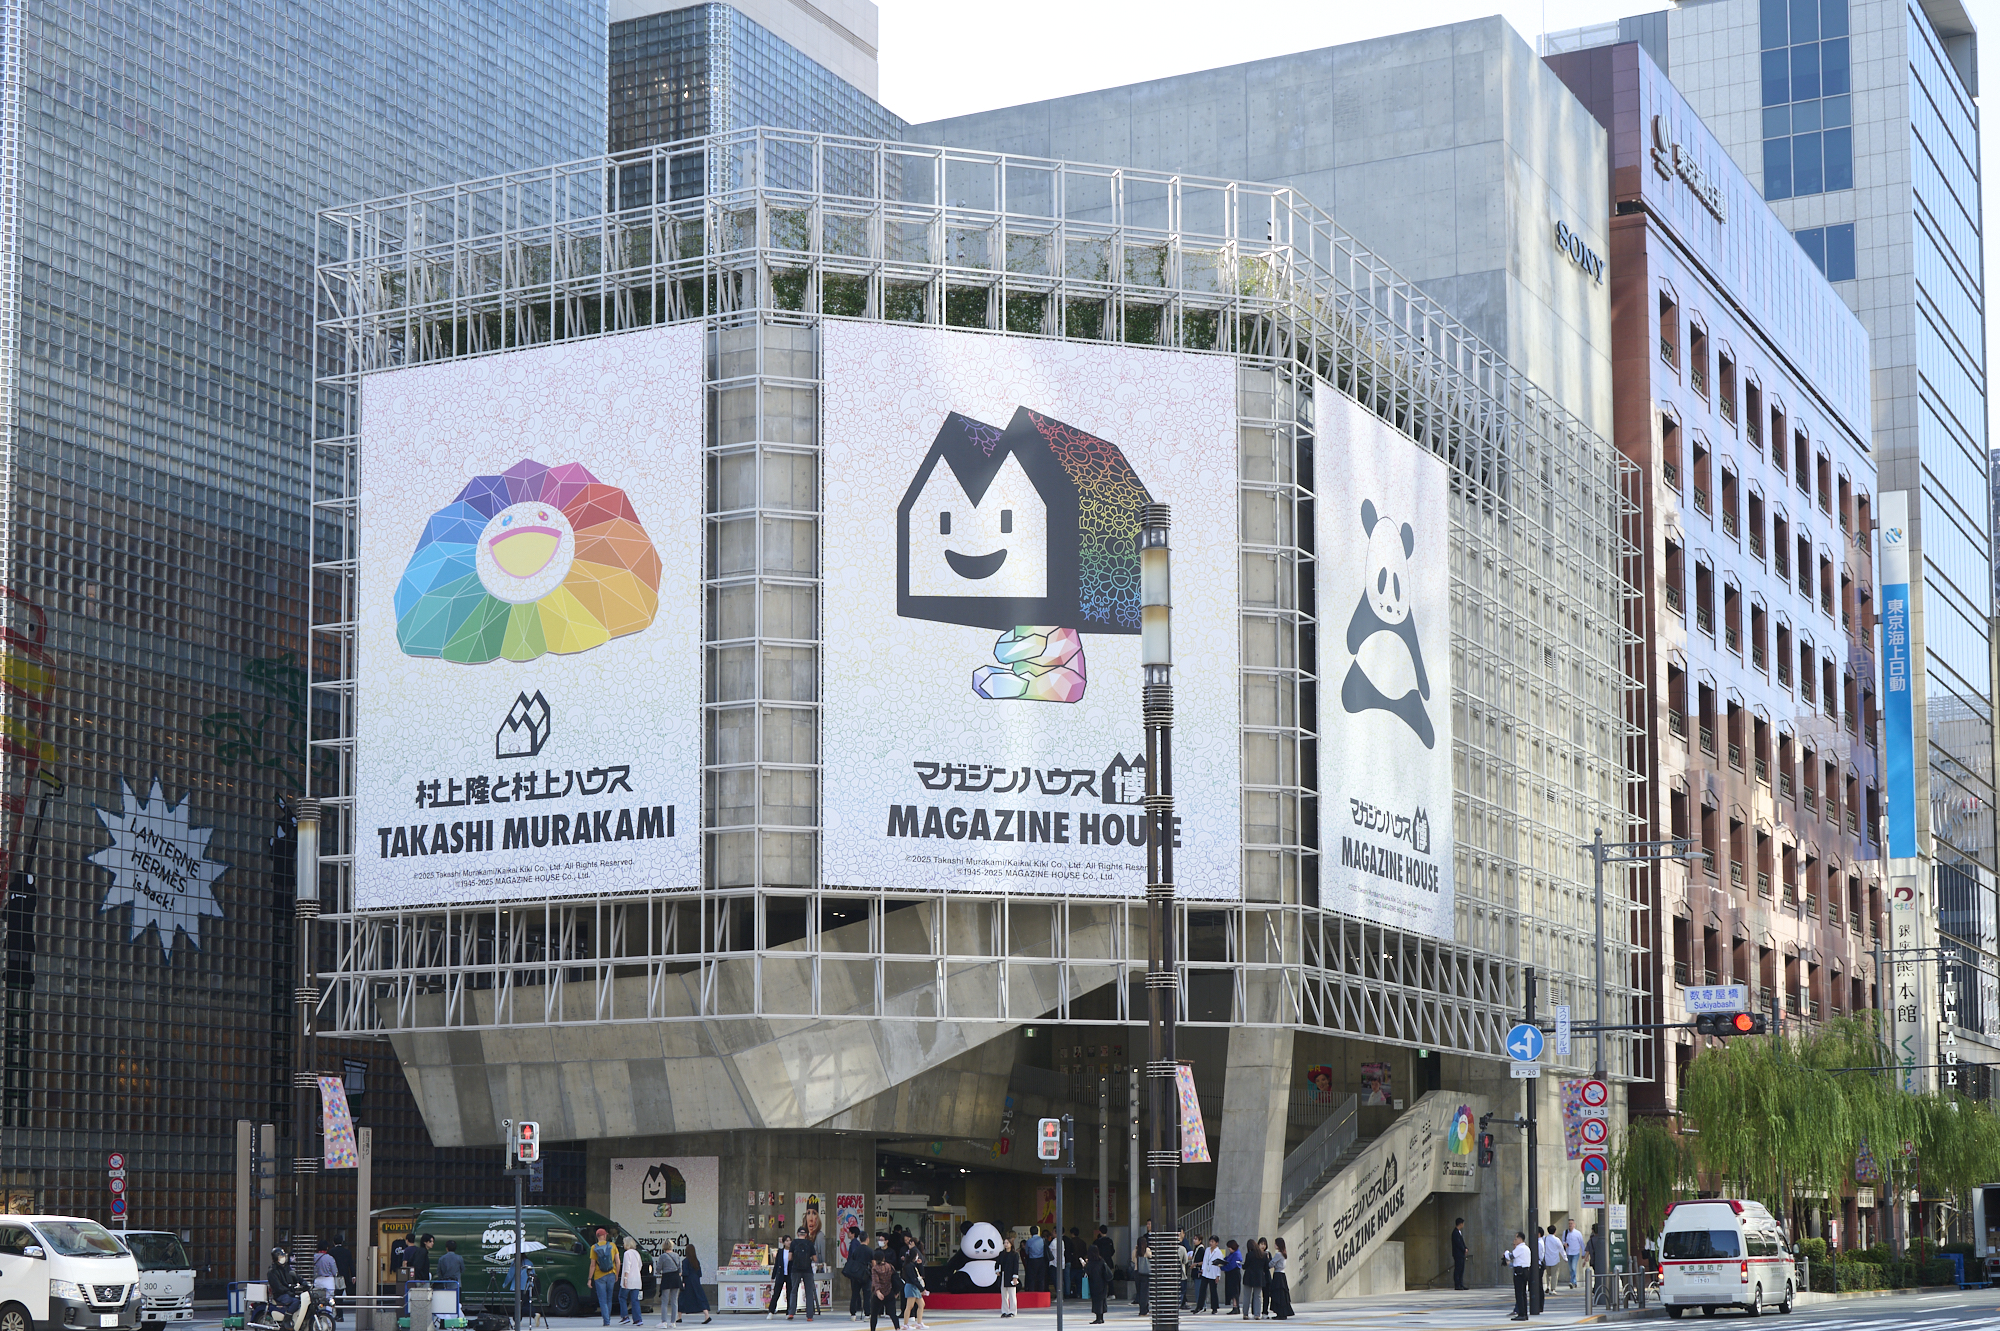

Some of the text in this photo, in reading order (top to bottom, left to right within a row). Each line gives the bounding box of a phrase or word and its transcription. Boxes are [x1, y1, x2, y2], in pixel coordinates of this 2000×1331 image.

[1557, 220, 1606, 285] SONY
[1887, 599, 1906, 692] 東京海上日動
[416, 764, 634, 809] 村上隆と村上ハウス
[378, 805, 676, 859] TAKASHI MURAKAMI
[886, 804, 1182, 849] MAGAZINE HOUE
[130, 817, 200, 879] LANTERNE
[131, 847, 187, 894] HERMÈS
[436, 871, 461, 879] Takashi
[520, 865, 533, 873] Kiki
[564, 862, 574, 870] All
[575, 861, 598, 869] Rights
[600, 859, 635, 868] Reserved.
[933, 856, 964, 866] Takashi
[1034, 858, 1049, 868] Kiki
[1069, 860, 1084, 869] Ltd.
[1085, 860, 1096, 870] All
[1098, 861, 1123, 871] Rights
[1005, 869, 1049, 879] MAGAZINE
[1051, 870, 1081, 880] HOUSE
[1100, 871, 1115, 881] Ltd.
[1342, 836, 1439, 894] MAGAZINE HOUSE
[133, 873, 175, 912] is back!
[495, 875, 533, 885] MAGAZINE
[534, 873, 561, 882] HOUSE
[1690, 988, 1739, 1001] 数寄屋橋
[1694, 1000, 1736, 1010] Sukiyabashi
[113, 1182, 123, 1190] 30
[836, 1194, 864, 1209] POPEYE
[488, 1220, 504, 1229] COME
[1326, 1218, 1376, 1284] MAGAZINE
[1377, 1184, 1405, 1231] HOUSE
[1679, 1264, 1723, 1272] 東京消防庁
